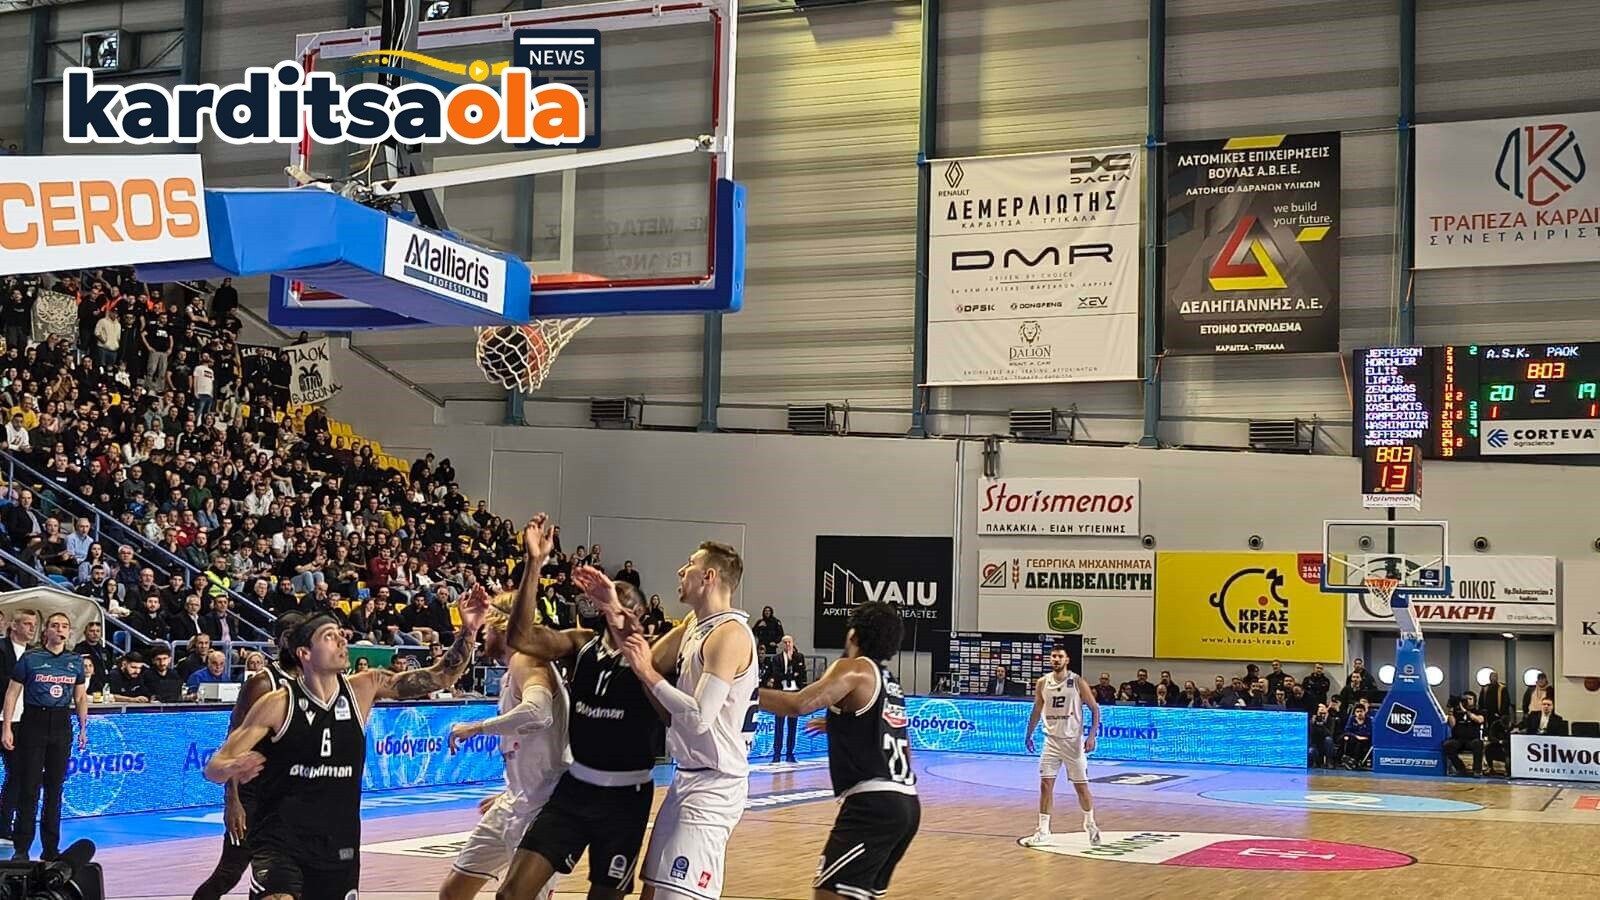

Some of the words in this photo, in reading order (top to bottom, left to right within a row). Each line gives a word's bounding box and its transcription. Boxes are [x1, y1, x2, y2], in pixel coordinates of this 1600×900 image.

[1177, 152, 1246, 167] ΛΑΤΟΜΙΚΕΣ
[1249, 146, 1330, 162] ΕΠΙΧΕΙΡΗΣΕΙΣ
[1208, 166, 1254, 179] ΒΟΥΛΑΣ
[1257, 163, 1301, 176] Α.Β.Ε.Ε.
[1070, 174, 1131, 184] DACIA
[938, 189, 970, 197] RENAULT
[1186, 185, 1235, 196] ΛΑΤΟΜΕΙΟ
[1236, 183, 1282, 193] ΑΔΡΑΝΩΝ
[1285, 180, 1321, 190] ΥΛΙΚΩΝ
[946, 190, 1117, 221] ΔΕΜΕΡΛΙΩΤΗΣ
[1273, 205, 1289, 213] we
[1291, 201, 1318, 212] build
[0, 177, 200, 250] CEROS
[961, 219, 1022, 229] ΚΑΡΔΙΤΣΑ
[1042, 214, 1097, 224] ΤΡΙΚΑΛΑ
[1273, 216, 1297, 227] your
[1299, 214, 1333, 224] future.
[1430, 212, 1527, 232] ΤΡΑΠΕΖΑ
[405, 233, 489, 289] Malliaris
[951, 243, 1113, 271] DMR
[428, 275, 487, 302] PROFESSIONAL
[1019, 301, 1063, 309] DONGFENG
[1077, 295, 1109, 307] XEV
[1180, 297, 1292, 314] ΔΕΛΗΓΙΑΝΝΗΣ
[1295, 298, 1323, 310] Α.Ε.
[1200, 324, 1237, 334] ΕΤΟΙΜΟ
[1239, 322, 1302, 333] ΣΚΥΡΟΔΕΜΑ
[1008, 346, 1051, 360] DALION
[1366, 348, 1423, 358] JEFFERSON
[1469, 346, 1478, 355] 2
[1486, 348, 1530, 358] A.S.K.
[1546, 346, 1579, 357] PAOK
[1365, 357, 1417, 366] HORCHLER
[1365, 367, 1398, 375] ELLIS
[1527, 363, 1565, 379] 8:03
[1365, 375, 1404, 384] LIAFIS
[1365, 384, 1416, 394] ZEVGARAS
[1490, 384, 1515, 401] 20
[1534, 384, 1546, 398] 2
[1578, 383, 1597, 400] 19
[1365, 393, 1417, 403] DIPLAROS
[1365, 402, 1423, 411] KASELAKIS
[1492, 406, 1497, 418] 1
[1591, 404, 1596, 417] 1
[1365, 411, 1429, 420] KAMPERIDIS
[1365, 420, 1429, 429] WASHINGTON
[1366, 429, 1423, 439] JEFFERSON
[1513, 429, 1595, 440] CORTEVA
[1376, 446, 1413, 462] 8:03
[1382, 466, 1407, 488] 13
[982, 483, 1134, 513] Storismenos
[986, 524, 1038, 532] ΠΛΑΚΑΚΙΑ
[1050, 524, 1073, 532] ΕΙΔΗ
[1079, 525, 1126, 533] ΥΓΙΕΙΝΗΣ
[1026, 559, 1076, 568] ΓΕΩΡΓΙΚΑ
[1079, 559, 1152, 569] ΜΗΧΑΝΗΜΑΤΑ
[1025, 572, 1152, 590] ΔΕΛΗΒΕΛΙΩΤΗ
[862, 580, 937, 606] VAIU
[1459, 581, 1496, 599] ΟΙΚΟΣ
[823, 608, 853, 617] ΑΡΧΙΤΕ
[1239, 609, 1289, 621] ΚΡΕΑΣ
[1239, 622, 1289, 634] ΚΡΕΑΣ
[1201, 637, 1295, 647] www.kreas-kreas.gr
[1052, 696, 1066, 708] 12
[1391, 712, 1413, 725] INSS
[320, 728, 332, 757] 6
[376, 735, 442, 758] υδρόγειος
[67, 750, 145, 781] ρόγειος
[1528, 767, 1567, 775] PARQUET
